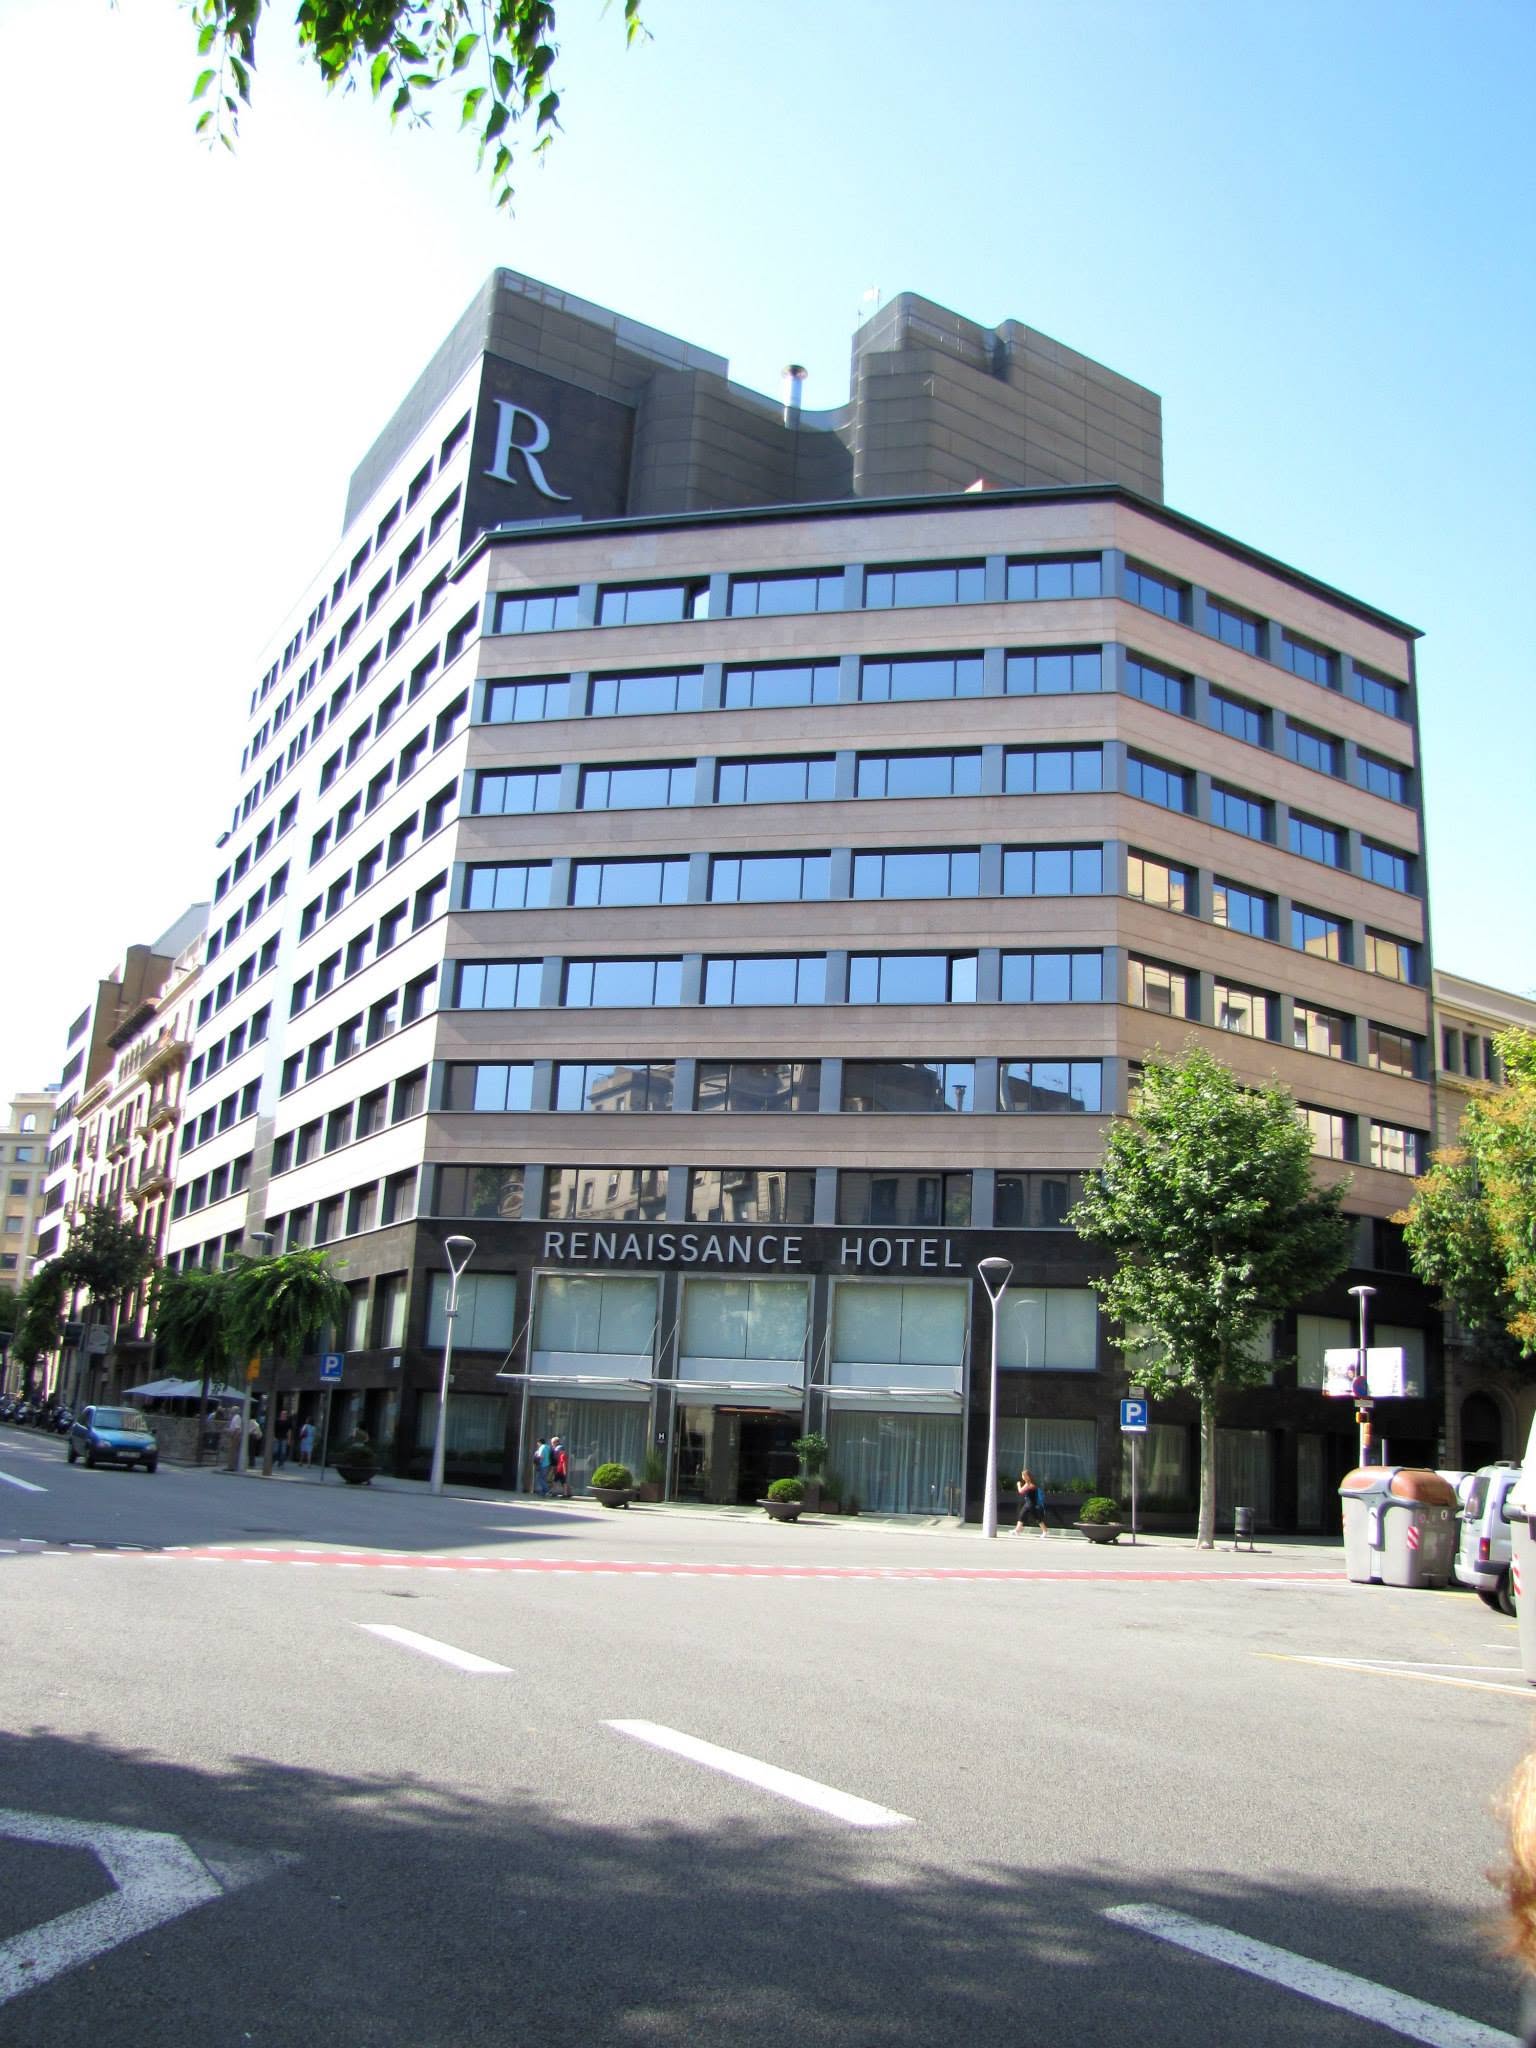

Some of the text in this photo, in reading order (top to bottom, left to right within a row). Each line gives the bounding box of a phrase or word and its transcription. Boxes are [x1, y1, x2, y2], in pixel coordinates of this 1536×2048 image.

[483, 398, 572, 500] R
[543, 1231, 962, 1268] RENAISSANCE HOTEL
[325, 1355, 338, 1374] P
[1126, 1402, 1142, 1423] P
